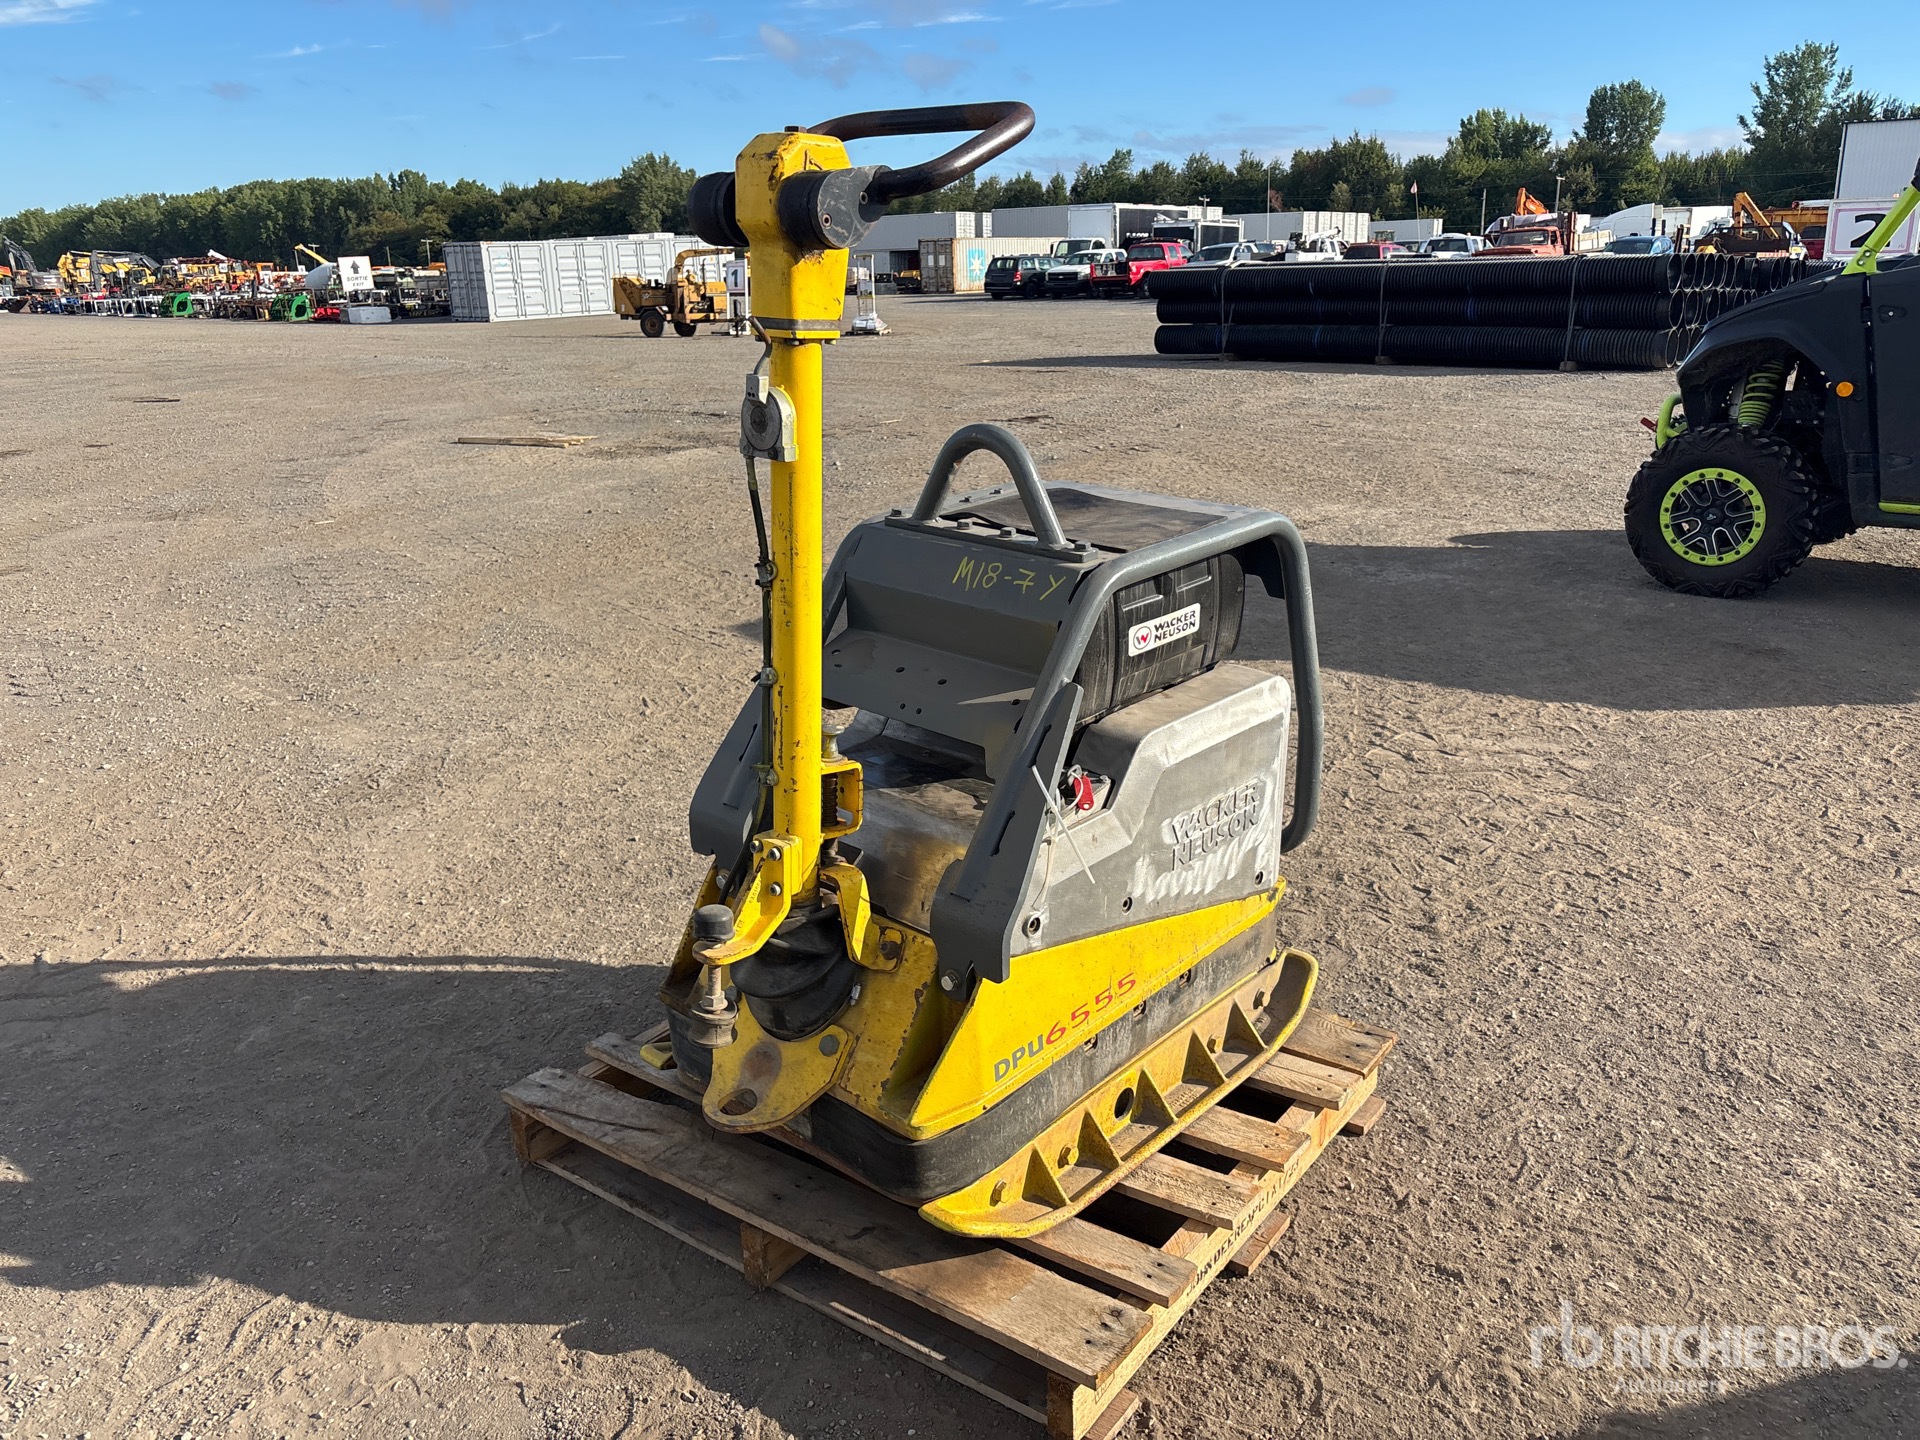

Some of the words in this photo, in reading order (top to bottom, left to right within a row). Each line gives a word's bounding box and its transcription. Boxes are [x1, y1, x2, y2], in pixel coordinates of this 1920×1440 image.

[730, 268, 739, 288] 1
[1153, 609, 1197, 633] WACKER
[1153, 618, 1197, 644] NEUSON
[1171, 780, 1261, 844] WACKER
[1171, 803, 1260, 871] NEUSON
